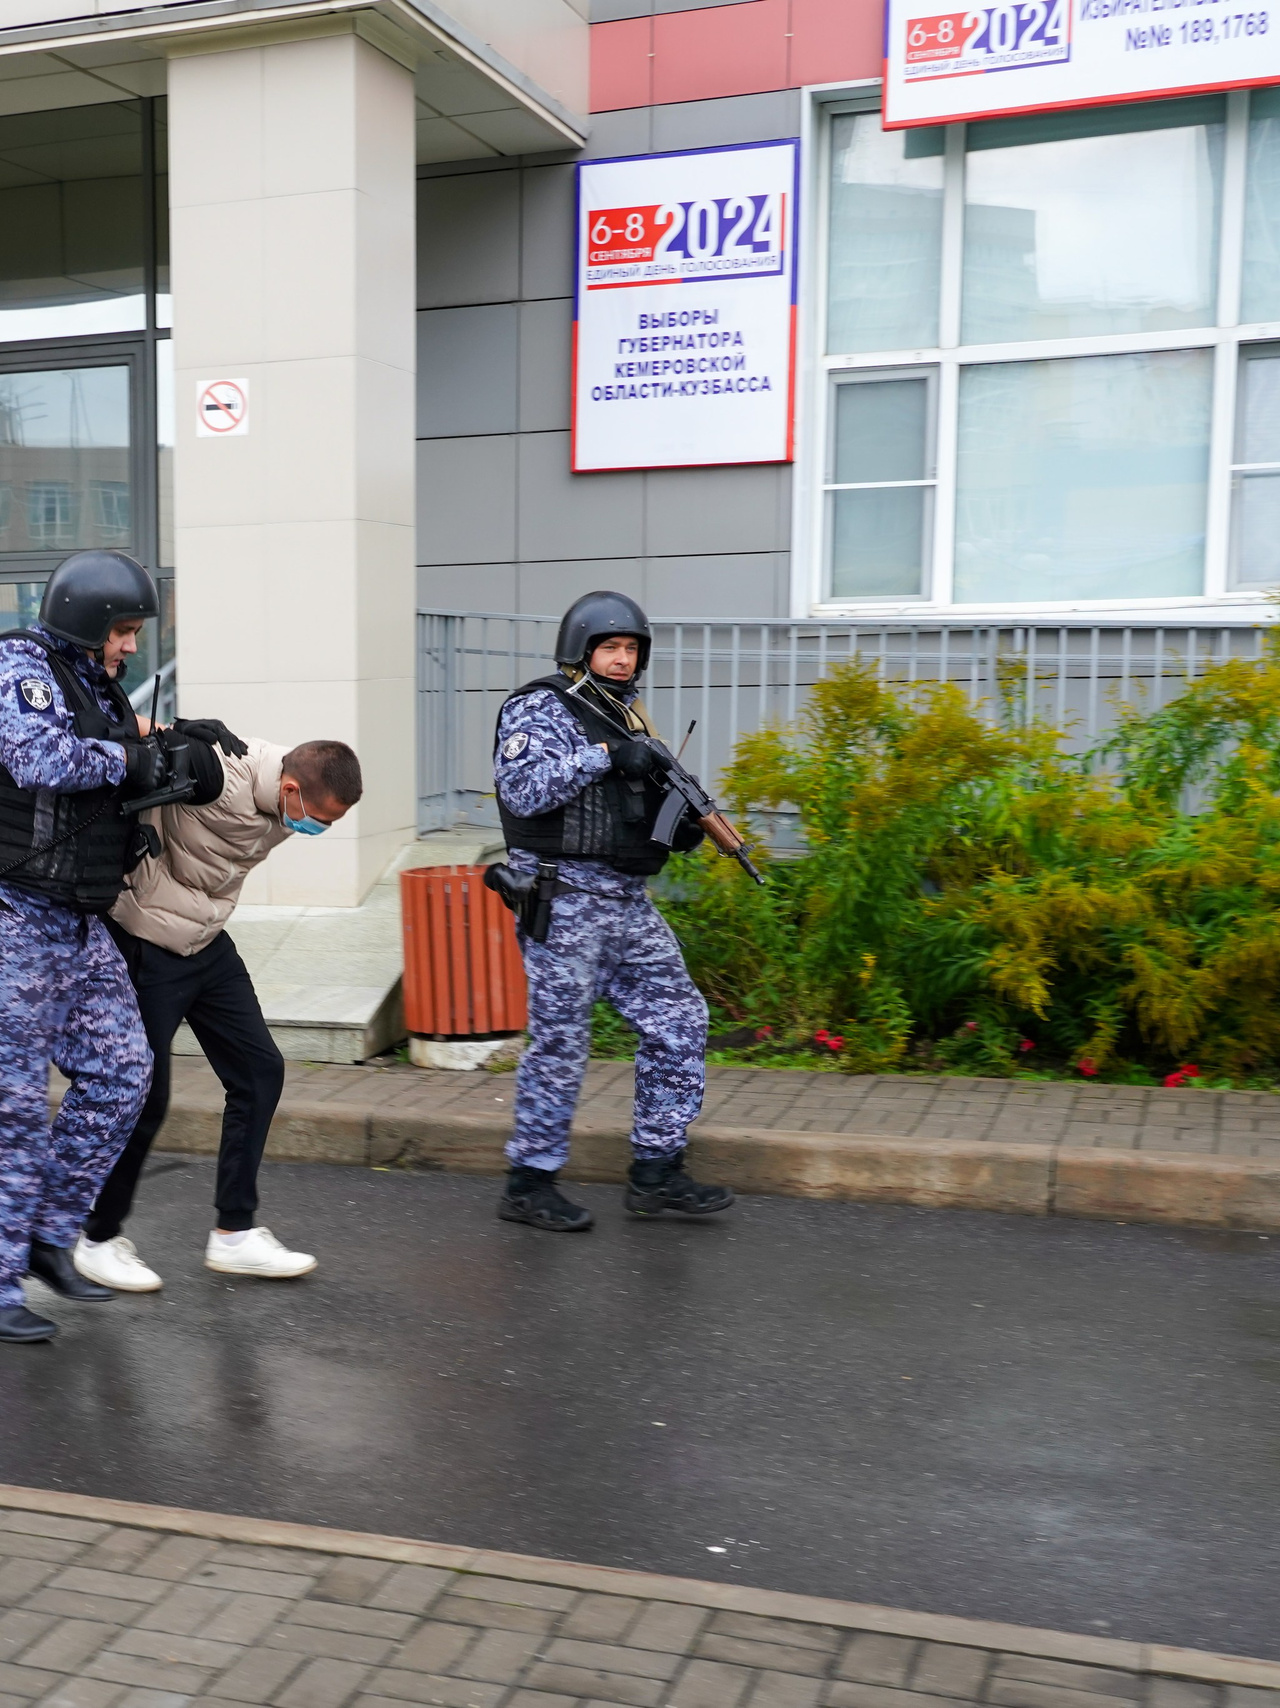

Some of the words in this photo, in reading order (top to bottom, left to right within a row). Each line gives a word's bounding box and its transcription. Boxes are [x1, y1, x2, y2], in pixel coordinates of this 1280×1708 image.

[908, 20, 955, 47] 6-8
[962, 0, 1065, 56] 2024
[590, 213, 645, 245] 6-8
[654, 194, 774, 260] 2024
[589, 247, 652, 262] СЕНТЯБРЯ
[586, 264, 641, 281] ЕДИНЫЙ
[644, 262, 676, 277] ДЕНЬ
[680, 255, 778, 273] ГОЛОСОВАНИЯ
[638, 309, 719, 330] ВЫБОРЫ
[618, 330, 744, 354] ГУБЕРНАТОРА
[614, 352, 747, 378] КЕМЕРОВСКОЙ
[591, 376, 772, 401] ОБЛАСТИ-КУЗБАССА
